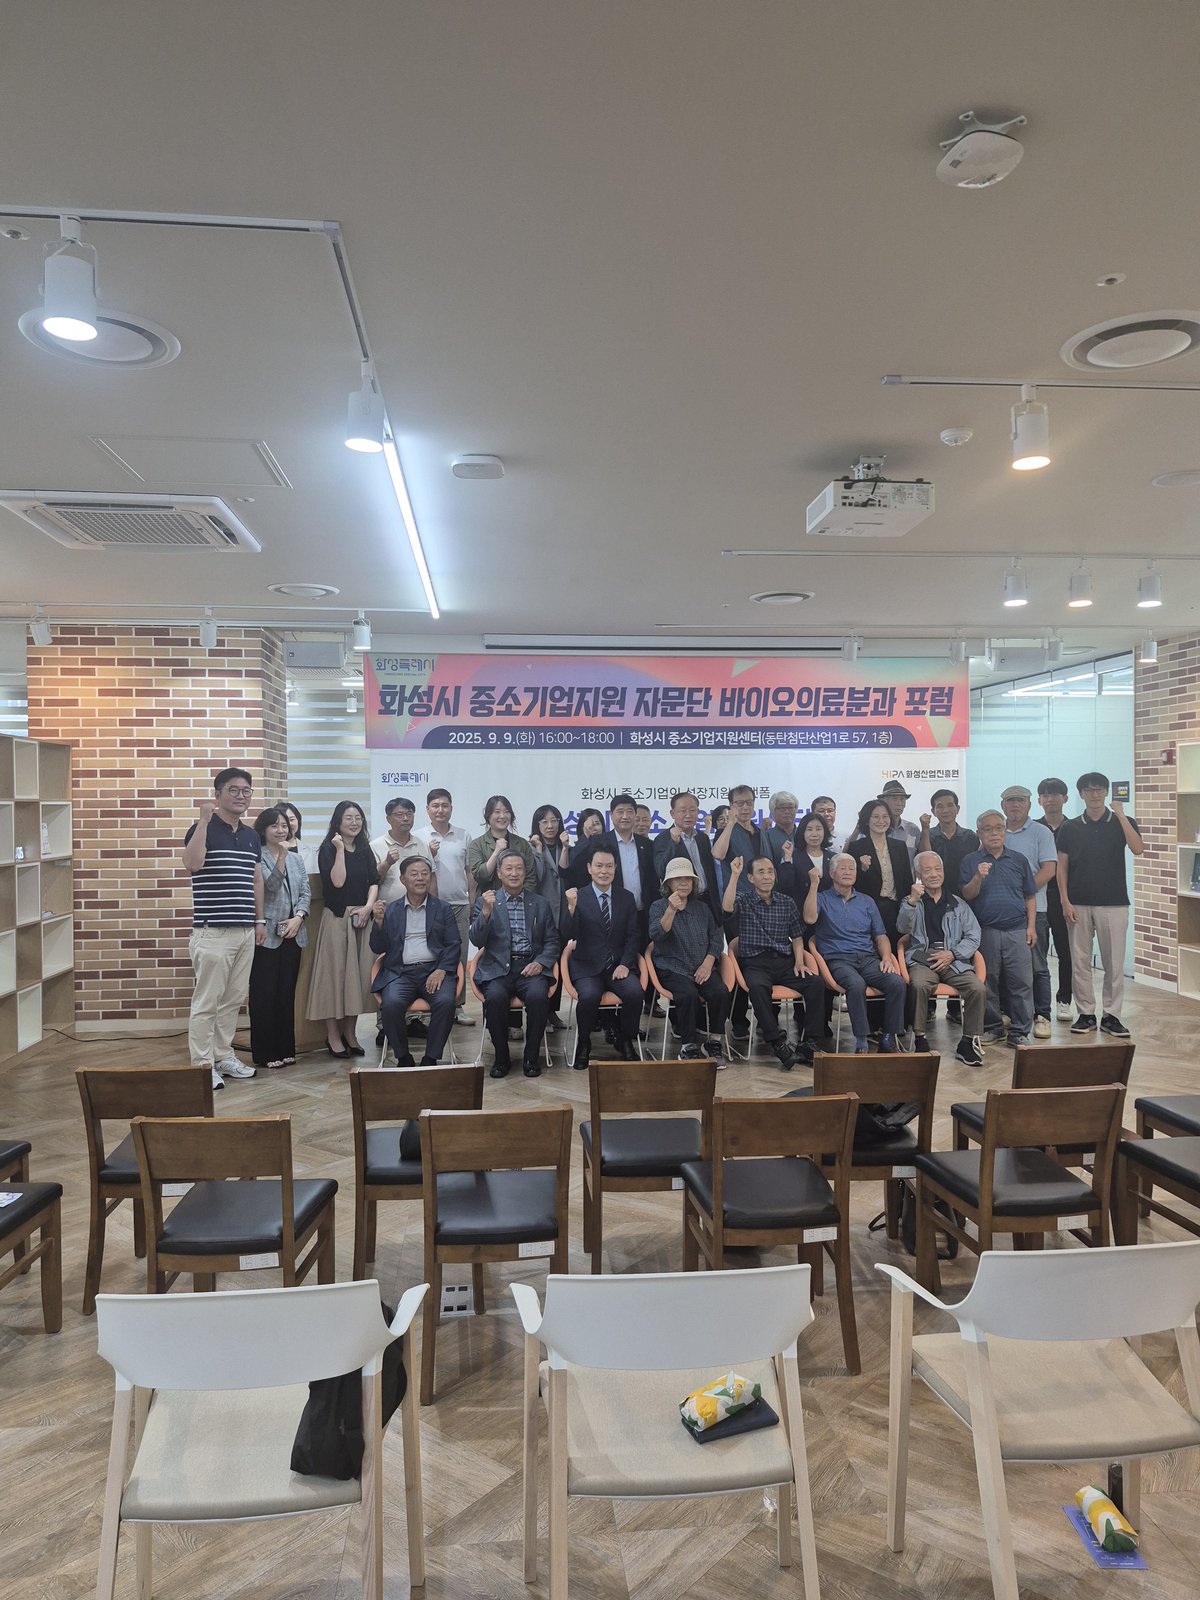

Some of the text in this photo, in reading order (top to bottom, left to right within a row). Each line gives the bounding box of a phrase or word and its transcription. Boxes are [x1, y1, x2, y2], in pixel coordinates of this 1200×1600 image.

[378, 684, 955, 718] 화성시 중소기업지원 자문단 바이오의료분과 포럼
[448, 731, 893, 746] 2025. 9. 9.(화) 16:00~18:00 화성시 중소기업지원센터(동탄첨단산업1로 57, 1층)
[906, 769, 959, 779] 화성산업진흥원
[581, 787, 617, 801] 화성시
